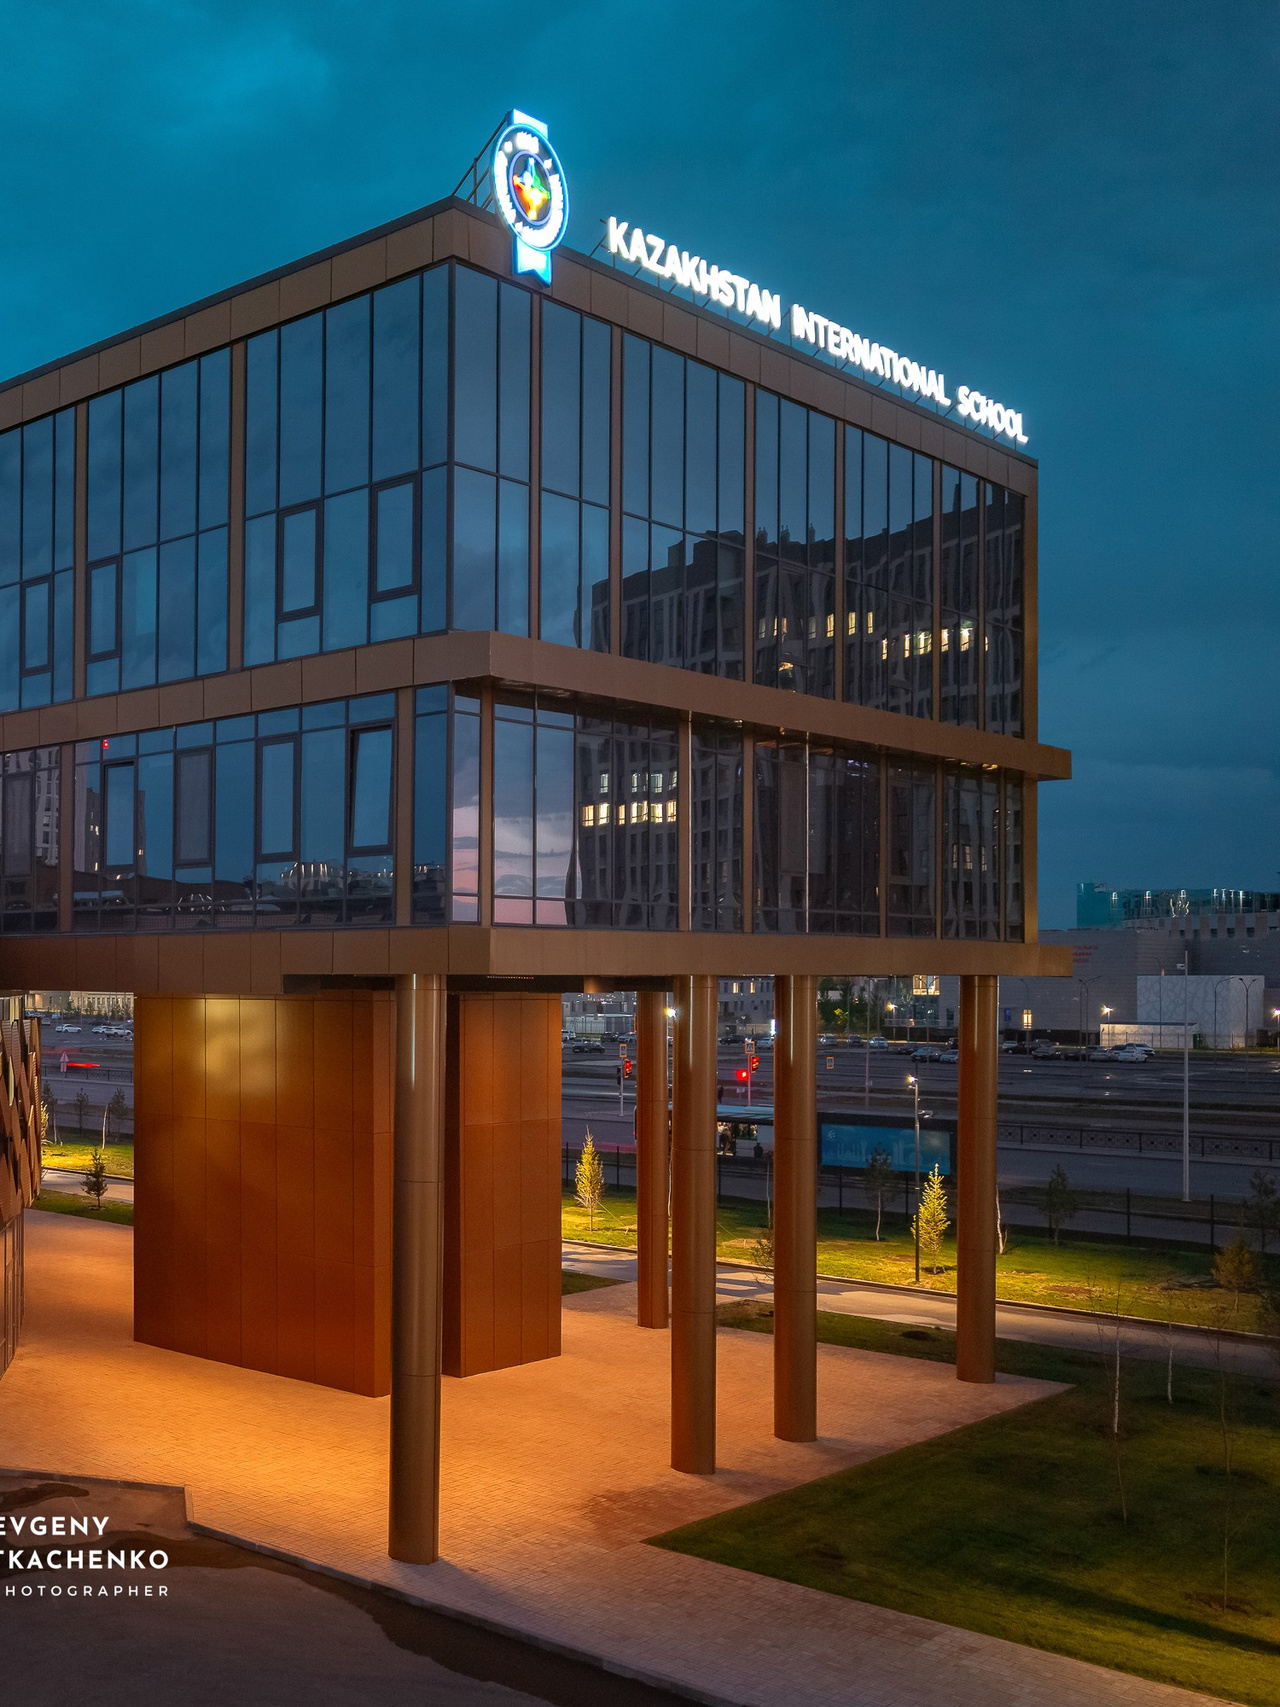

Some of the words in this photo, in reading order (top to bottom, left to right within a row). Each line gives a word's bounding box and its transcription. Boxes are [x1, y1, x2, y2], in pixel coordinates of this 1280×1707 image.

[607, 215, 781, 329] KAZAKHSTAN
[791, 303, 951, 406] INTERNATIONAL
[957, 385, 1029, 443] SCHOOL
